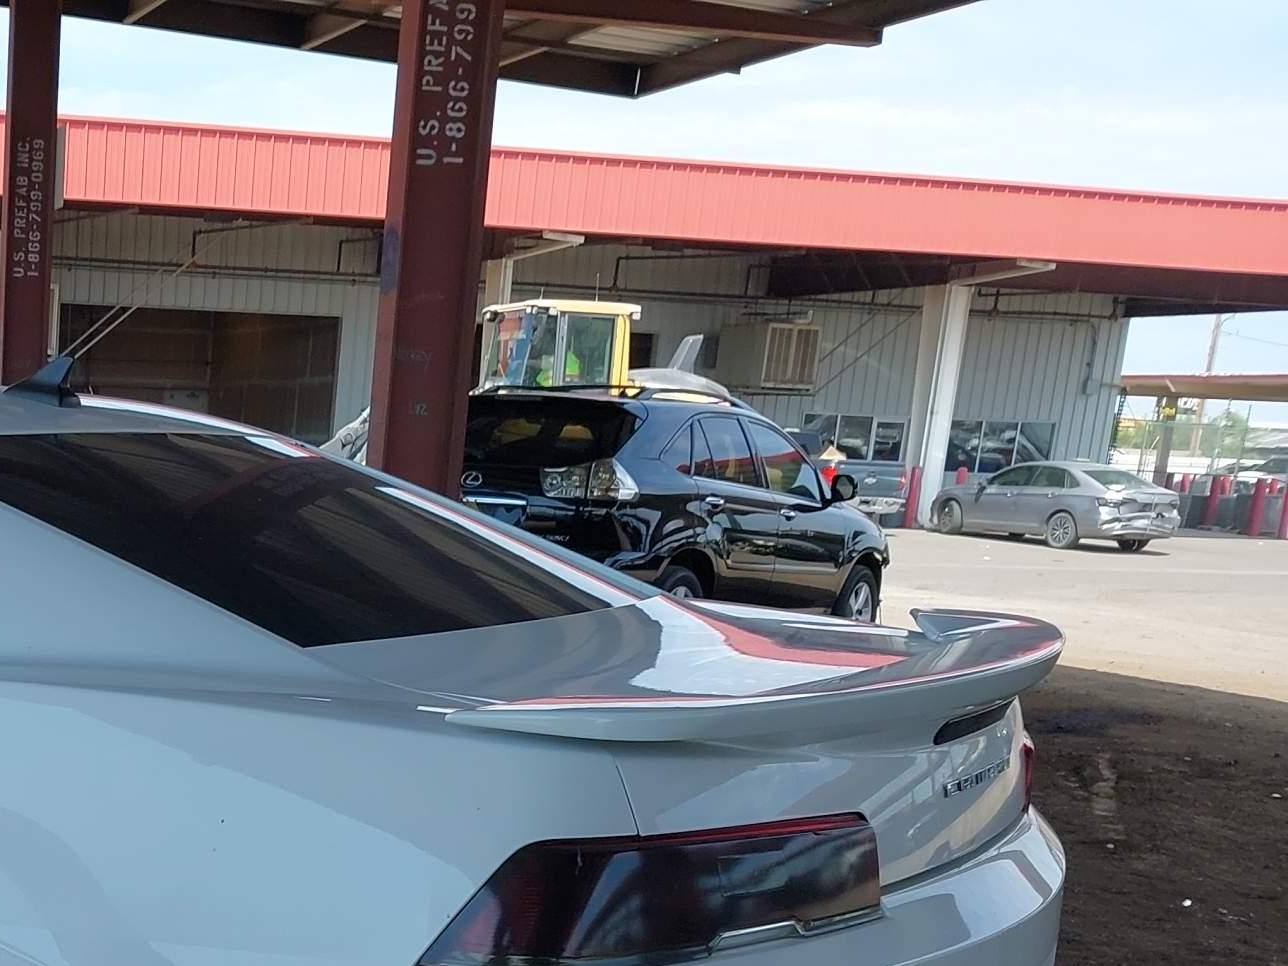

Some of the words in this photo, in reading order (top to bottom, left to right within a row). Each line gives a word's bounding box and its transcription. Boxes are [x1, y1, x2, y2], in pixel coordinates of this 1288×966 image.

[17, 136, 31, 168] INC.
[416, 111, 441, 165] U.S.
[14, 176, 28, 238] PREFAB
[27, 139, 45, 276] 1-866-799-0969
[13, 246, 25, 277] U.S.
